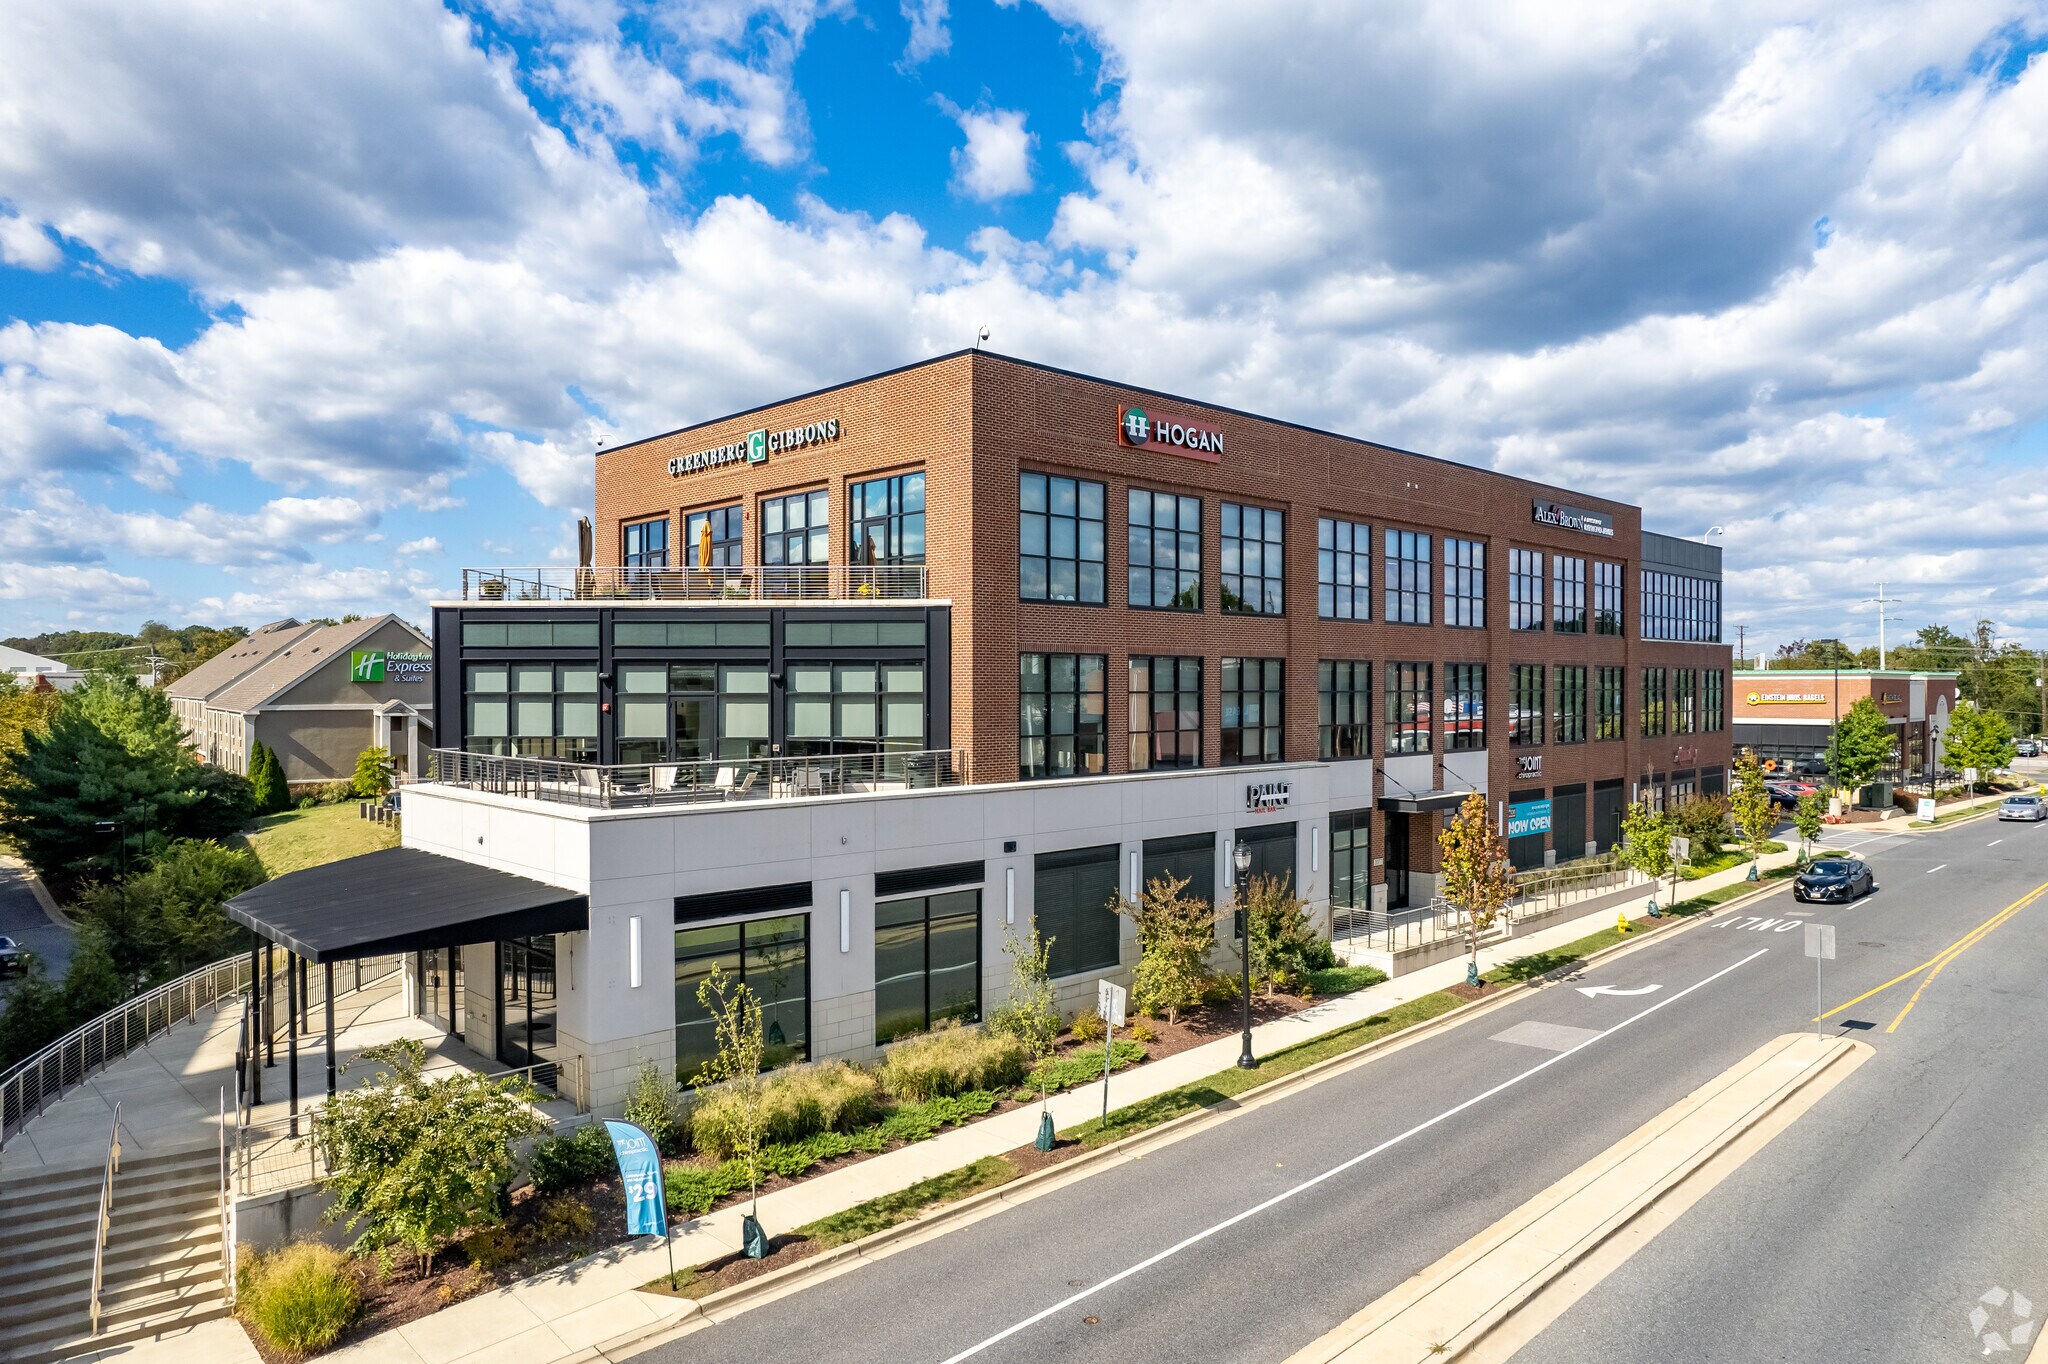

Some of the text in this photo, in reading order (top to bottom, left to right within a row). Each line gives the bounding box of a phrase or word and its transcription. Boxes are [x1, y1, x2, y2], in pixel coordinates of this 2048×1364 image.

[1156, 420, 1224, 454] HOGAN
[667, 418, 838, 474] GREENBERG G GIBBONS
[387, 651, 432, 661] Holiday Inn
[387, 661, 432, 674] Express
[402, 674, 423, 682] Suites
[1761, 693, 1785, 701] EINSTEIN
[1803, 693, 1825, 701] BAGELS
[1524, 755, 1542, 771] JOINT
[1247, 782, 1292, 808] PAINT
[1508, 816, 1550, 835] NOW OPEN
[1711, 916, 1803, 932] ONLY
[626, 1136, 646, 1149] JOINT
[628, 1181, 657, 1203] $29
